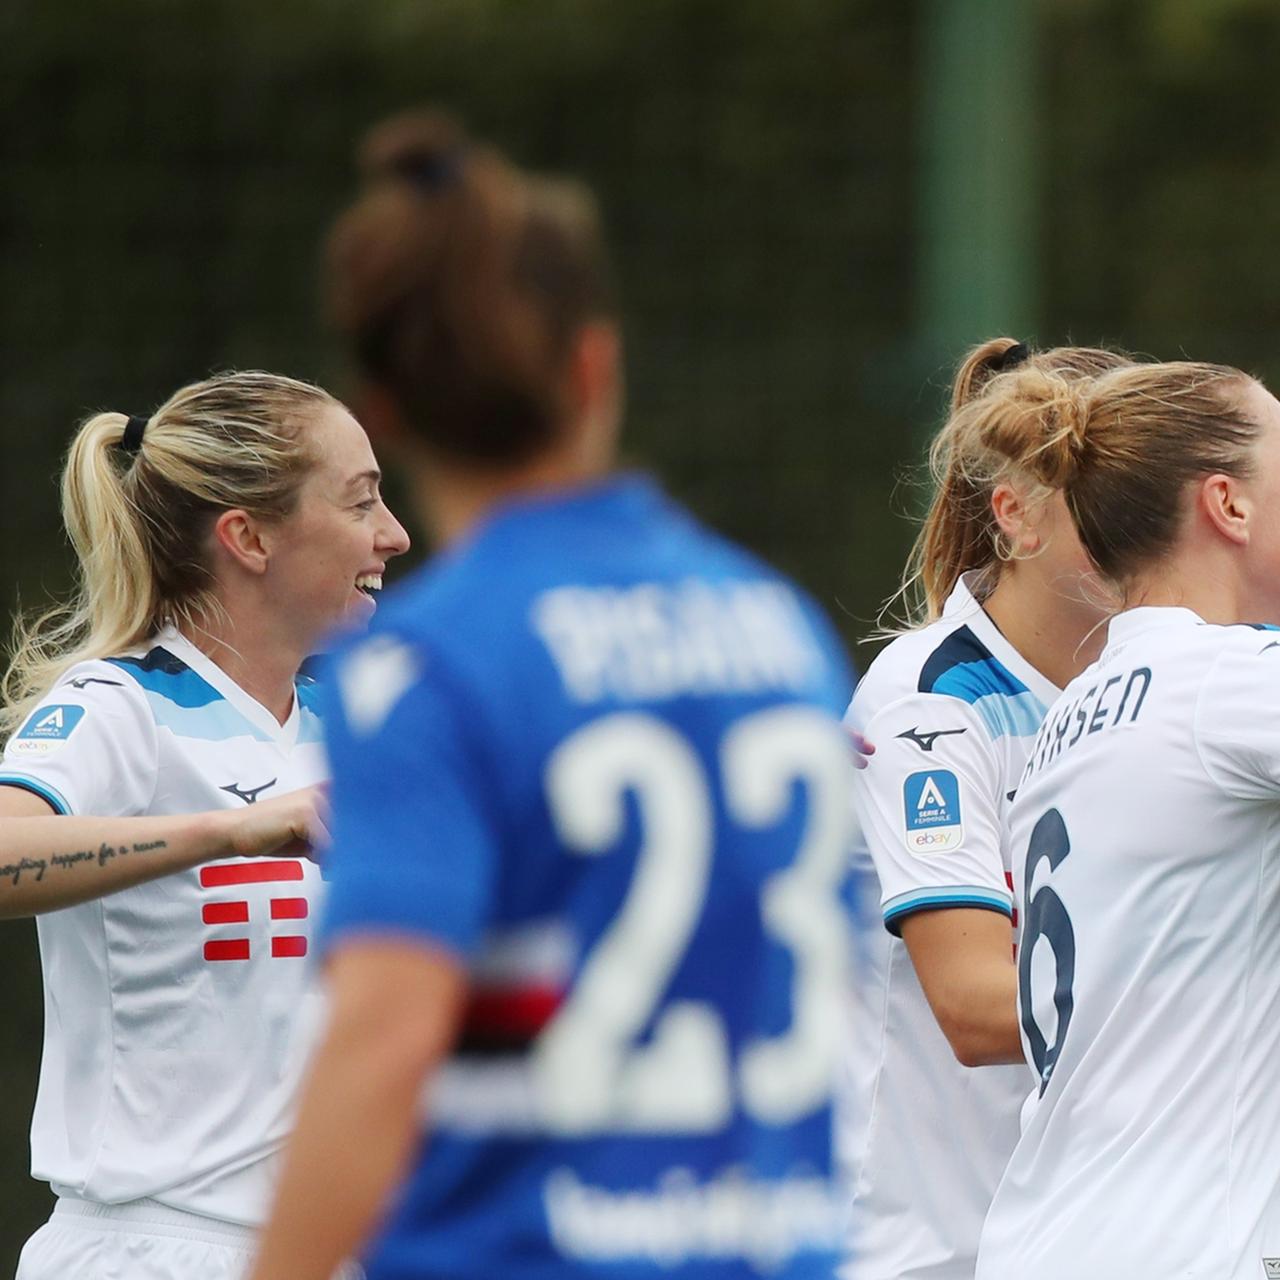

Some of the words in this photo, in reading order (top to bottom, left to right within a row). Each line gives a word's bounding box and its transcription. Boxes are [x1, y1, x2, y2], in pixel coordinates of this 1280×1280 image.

[530, 707, 853, 1137] 23
[916, 832, 952, 845] ebay
[1017, 806, 1076, 1100] 6
